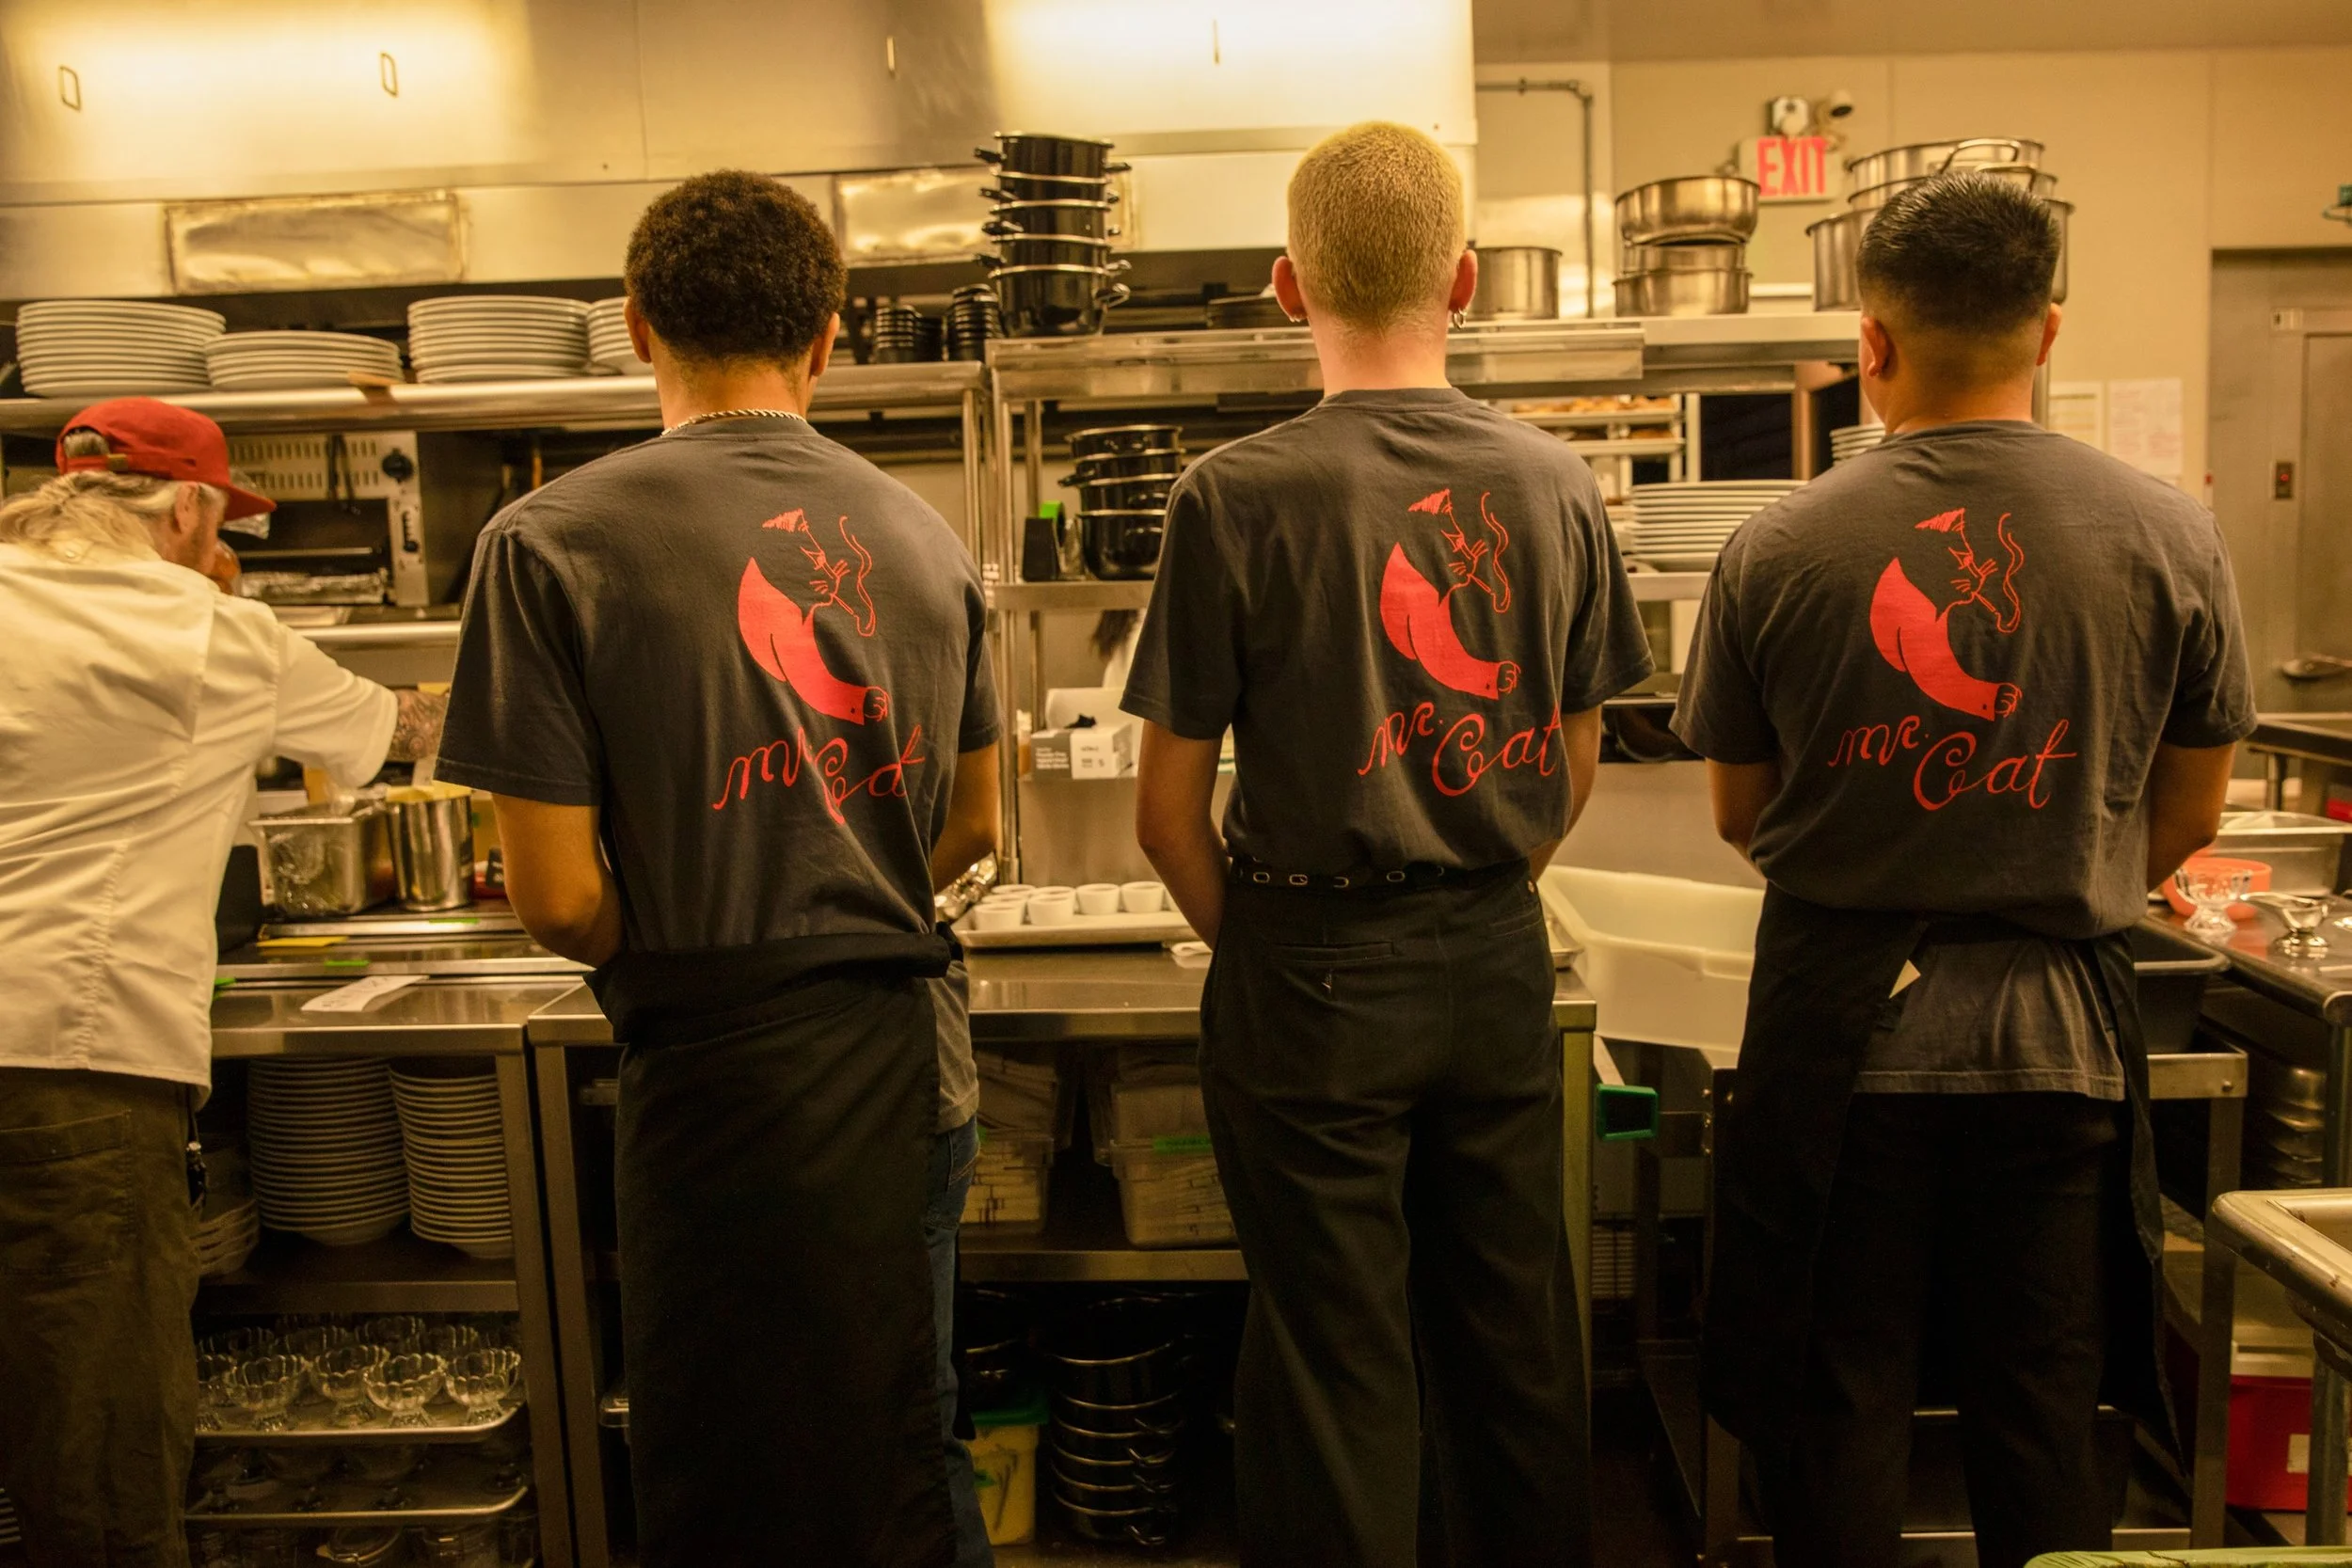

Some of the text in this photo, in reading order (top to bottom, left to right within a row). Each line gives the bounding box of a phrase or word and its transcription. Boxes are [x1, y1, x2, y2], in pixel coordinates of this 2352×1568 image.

[1756, 136, 1827, 196] EXIT
[1432, 699, 1563, 797] Cat
[1914, 718, 2077, 811] Cat
